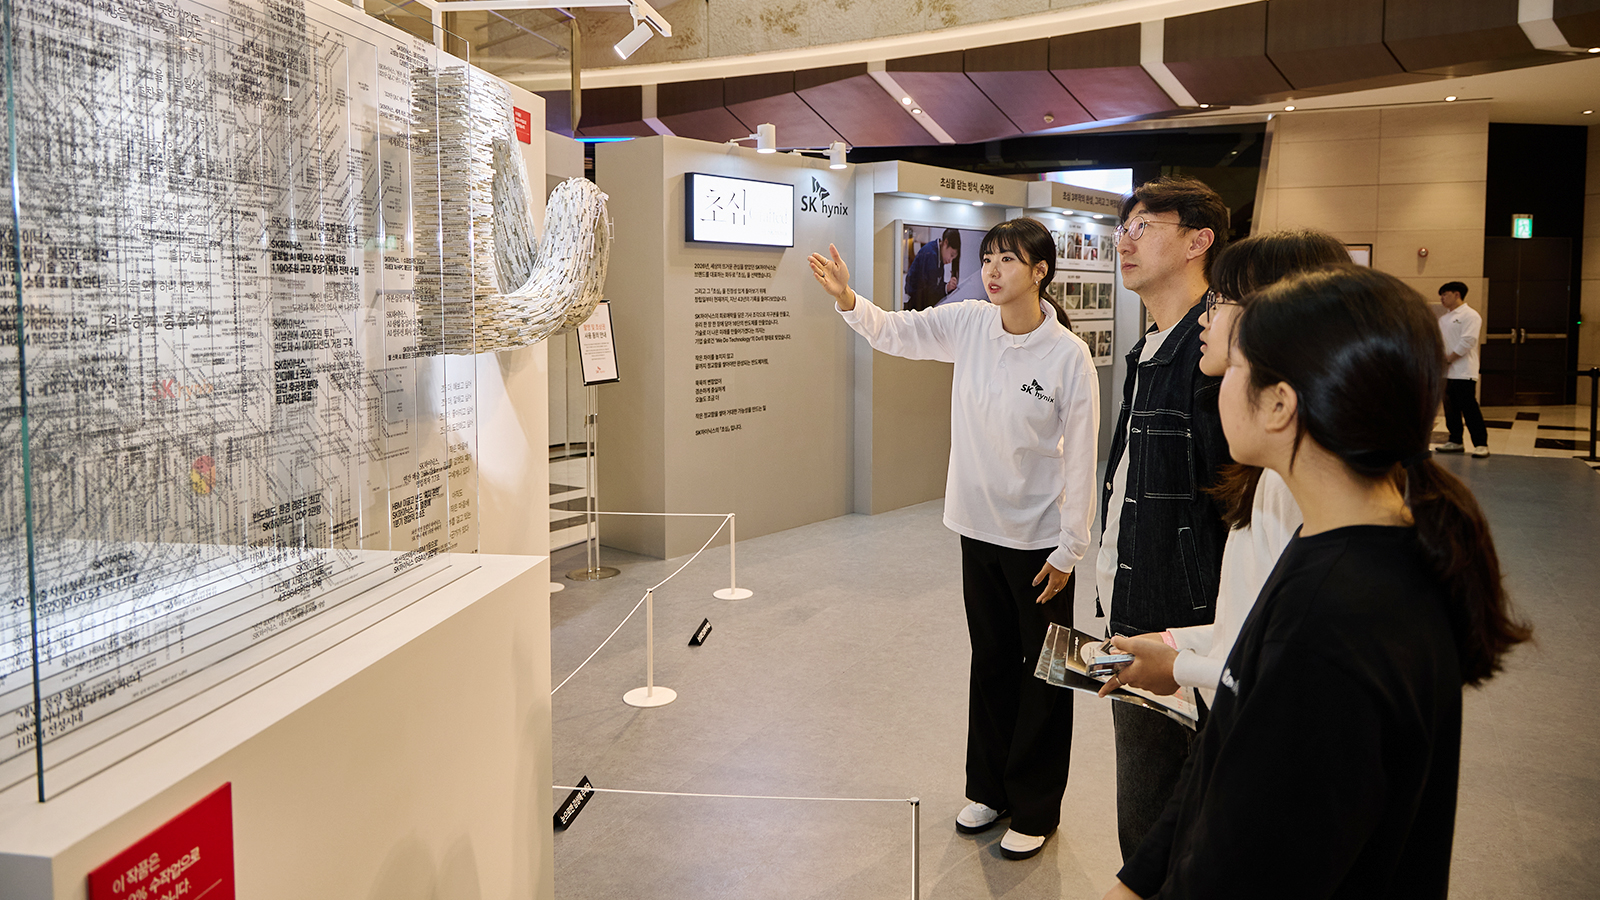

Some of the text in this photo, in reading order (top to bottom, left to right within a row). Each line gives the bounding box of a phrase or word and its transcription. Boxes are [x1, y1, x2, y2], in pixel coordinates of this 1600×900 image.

[940, 177, 994, 194] 초심을 담는 방식, 수작업
[699, 188, 747, 226] 초심
[801, 195, 848, 218] SK hynix
[297, 253, 313, 262] 메모리
[314, 254, 324, 262] 수요
[300, 264, 311, 273] 규모
[274, 329, 334, 341] 서남권에 400조원 투자
[152, 380, 175, 401] SK
[1020, 383, 1055, 404] SK hynix
[695, 427, 719, 436] SK하이닉스의
[112, 852, 162, 894] 이 작품은
[148, 846, 201, 894] 수작업으로
